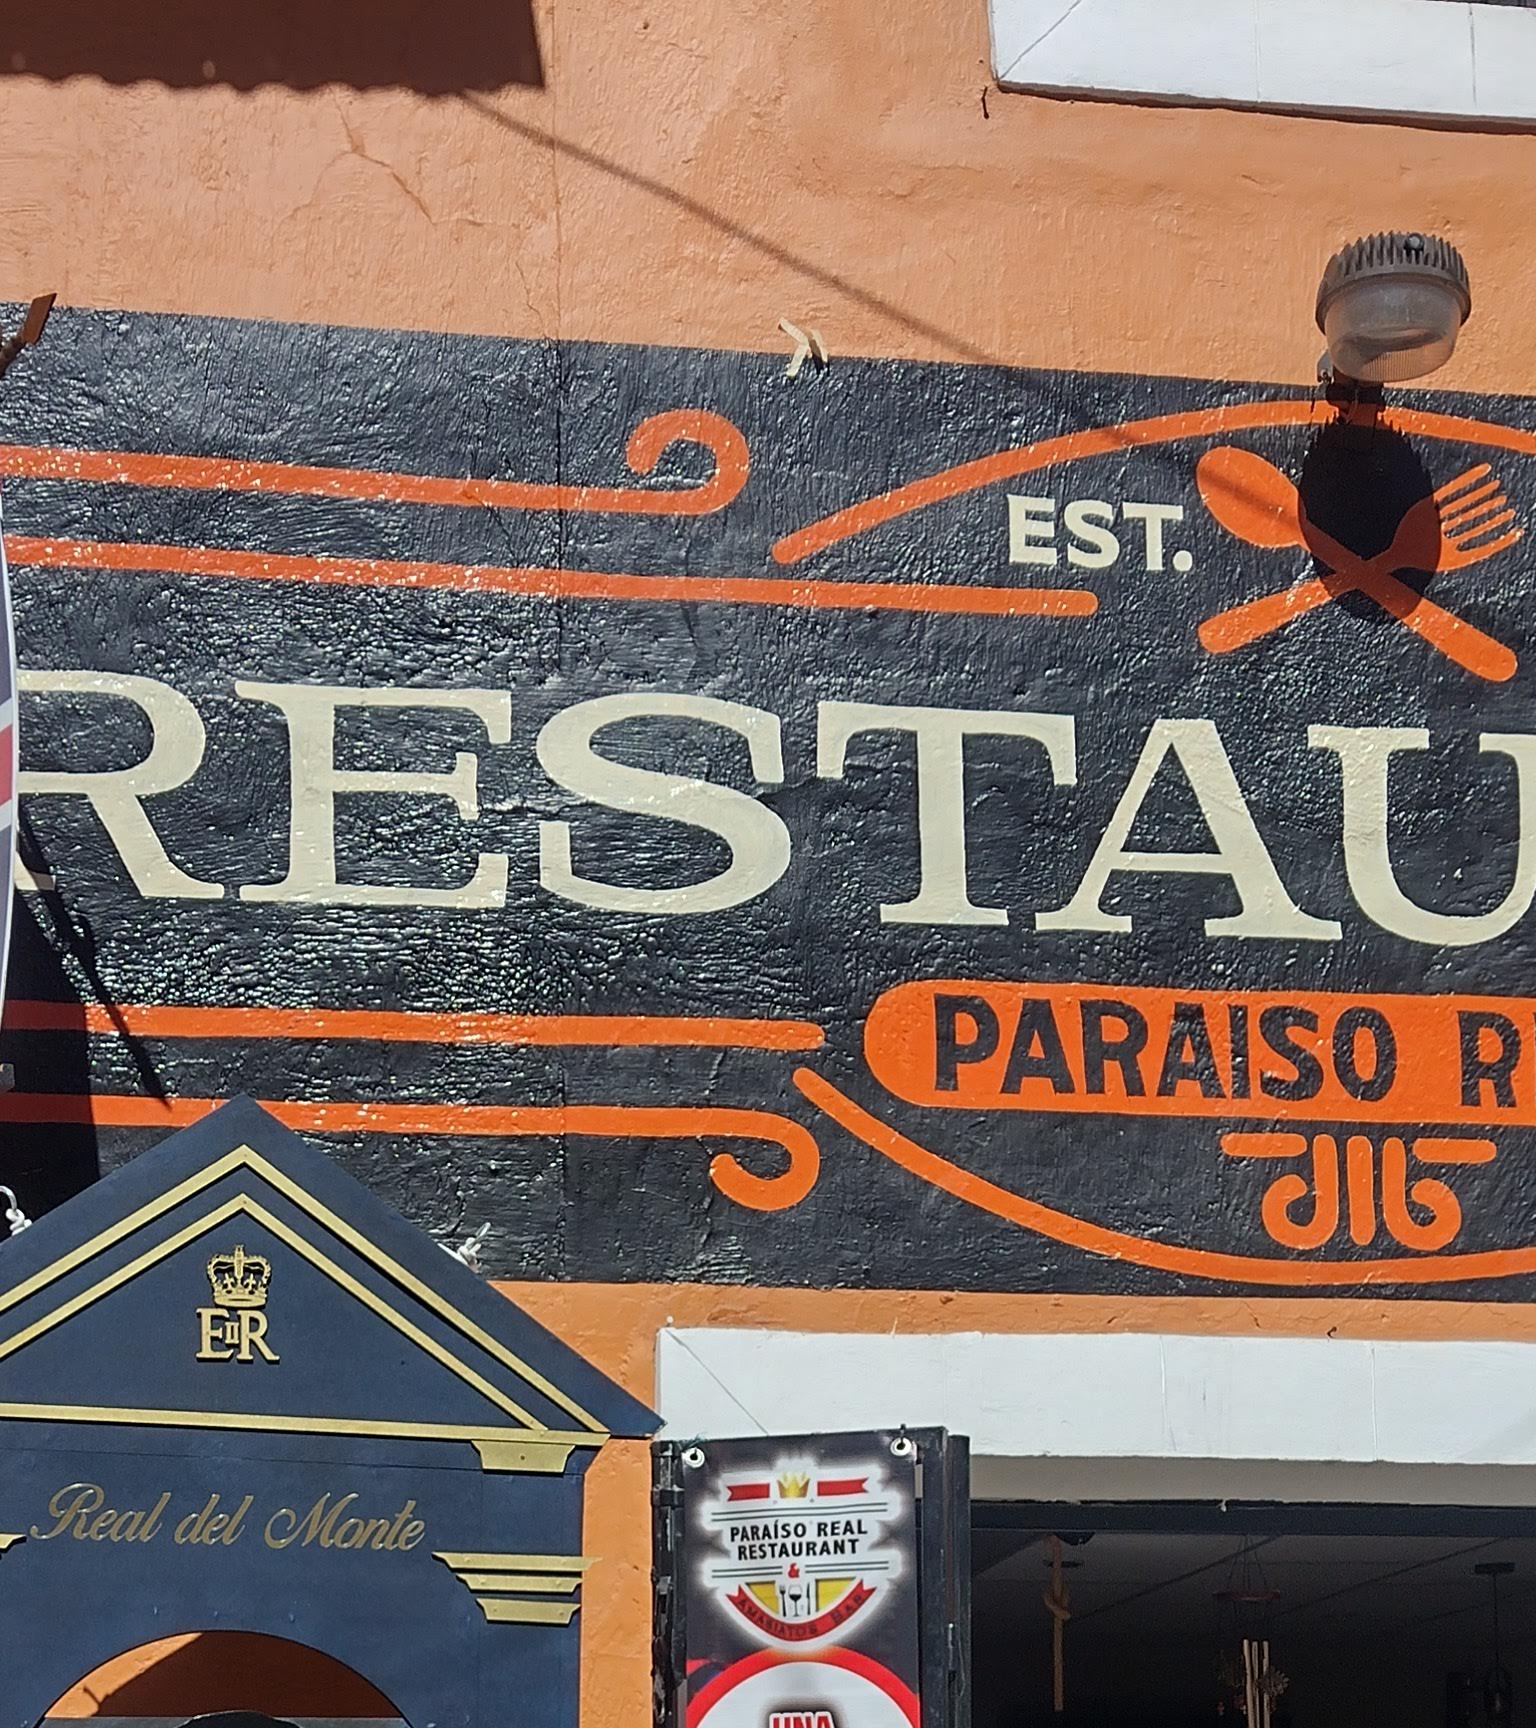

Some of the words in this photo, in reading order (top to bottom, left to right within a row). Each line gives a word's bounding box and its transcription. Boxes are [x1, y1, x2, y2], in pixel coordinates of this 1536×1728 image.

[1007, 493, 1192, 572] EST.
[29, 1481, 173, 1543] Real
[173, 1492, 255, 1546] del
[263, 1491, 426, 1551] Monte
[730, 1519, 807, 1543] PARAÍSO
[817, 1519, 868, 1538] REAL
[737, 1538, 860, 1561] RESTAURANT
[787, 1562, 800, 1579] &
